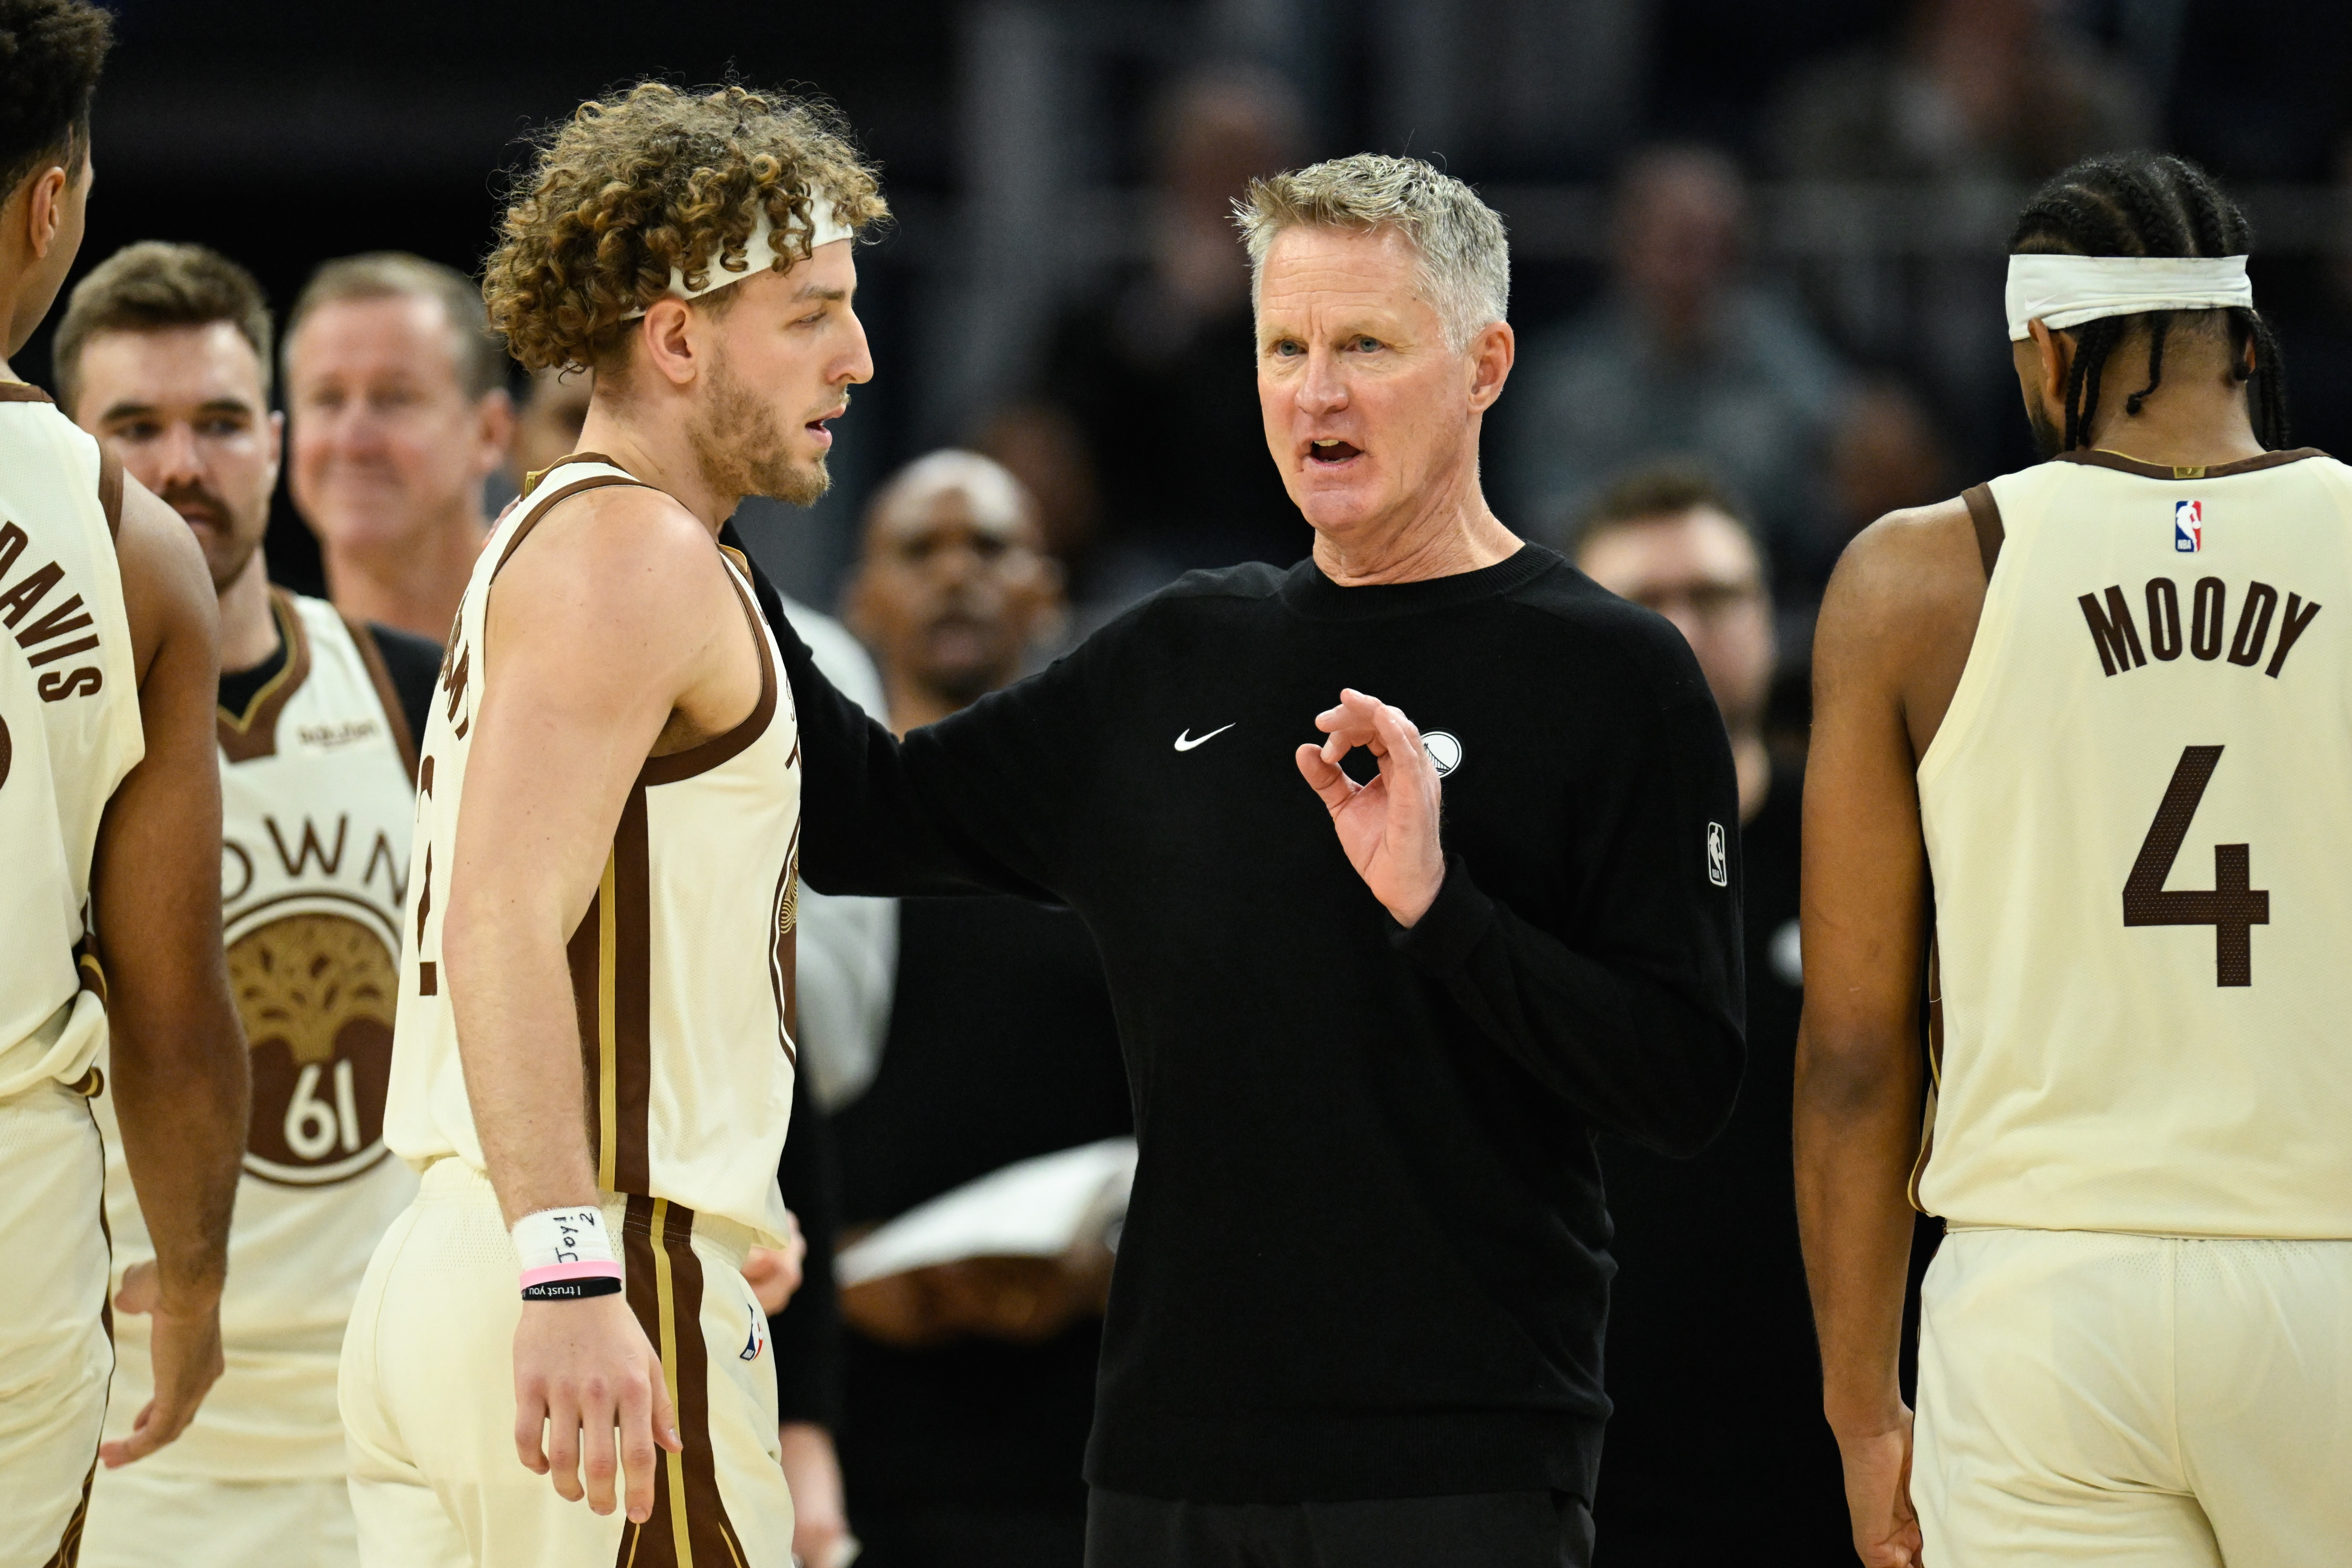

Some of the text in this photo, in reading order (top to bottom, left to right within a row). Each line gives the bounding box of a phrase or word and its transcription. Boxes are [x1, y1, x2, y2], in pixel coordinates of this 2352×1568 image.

[2177, 539, 2192, 550] NBA
[2078, 576, 2322, 679] MOODY
[1712, 869, 1720, 879] NBA
[2122, 745, 2269, 987] 4
[285, 1058, 361, 1160] 61
[553, 1216, 578, 1263] Joy!
[548, 1286, 575, 1297] trust
[577, 1286, 581, 1295] I
